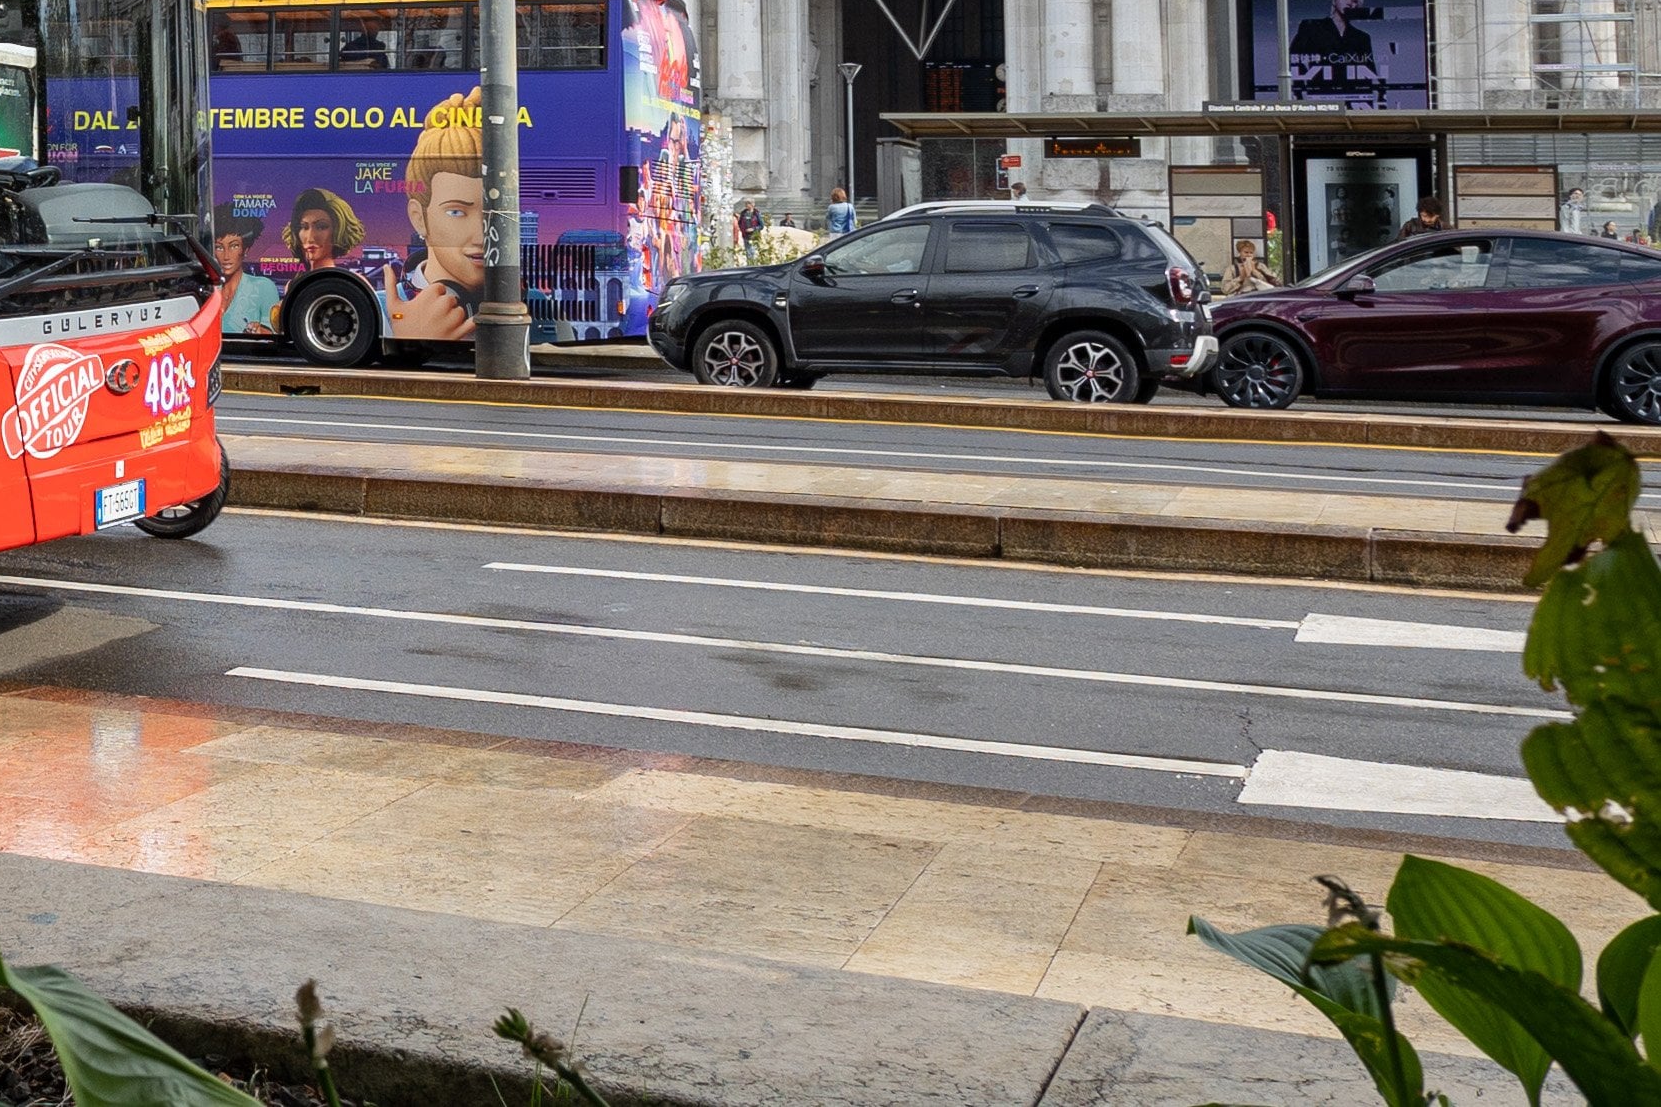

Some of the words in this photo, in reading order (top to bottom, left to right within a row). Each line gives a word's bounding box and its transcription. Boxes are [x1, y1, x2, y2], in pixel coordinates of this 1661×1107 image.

[74, 111, 120, 130] DAL
[314, 106, 384, 128] SOLO
[390, 106, 423, 128] AL
[431, 106, 533, 128] CINEA
[355, 168, 392, 180] JAKE
[355, 181, 373, 193] LA
[374, 180, 426, 193] FURIA
[233, 199, 276, 208] TAMARA
[260, 263, 306, 272] REGINA
[144, 354, 175, 415] 48
[15, 361, 99, 442] OFFICIAL
[45, 407, 83, 448] TOUR
